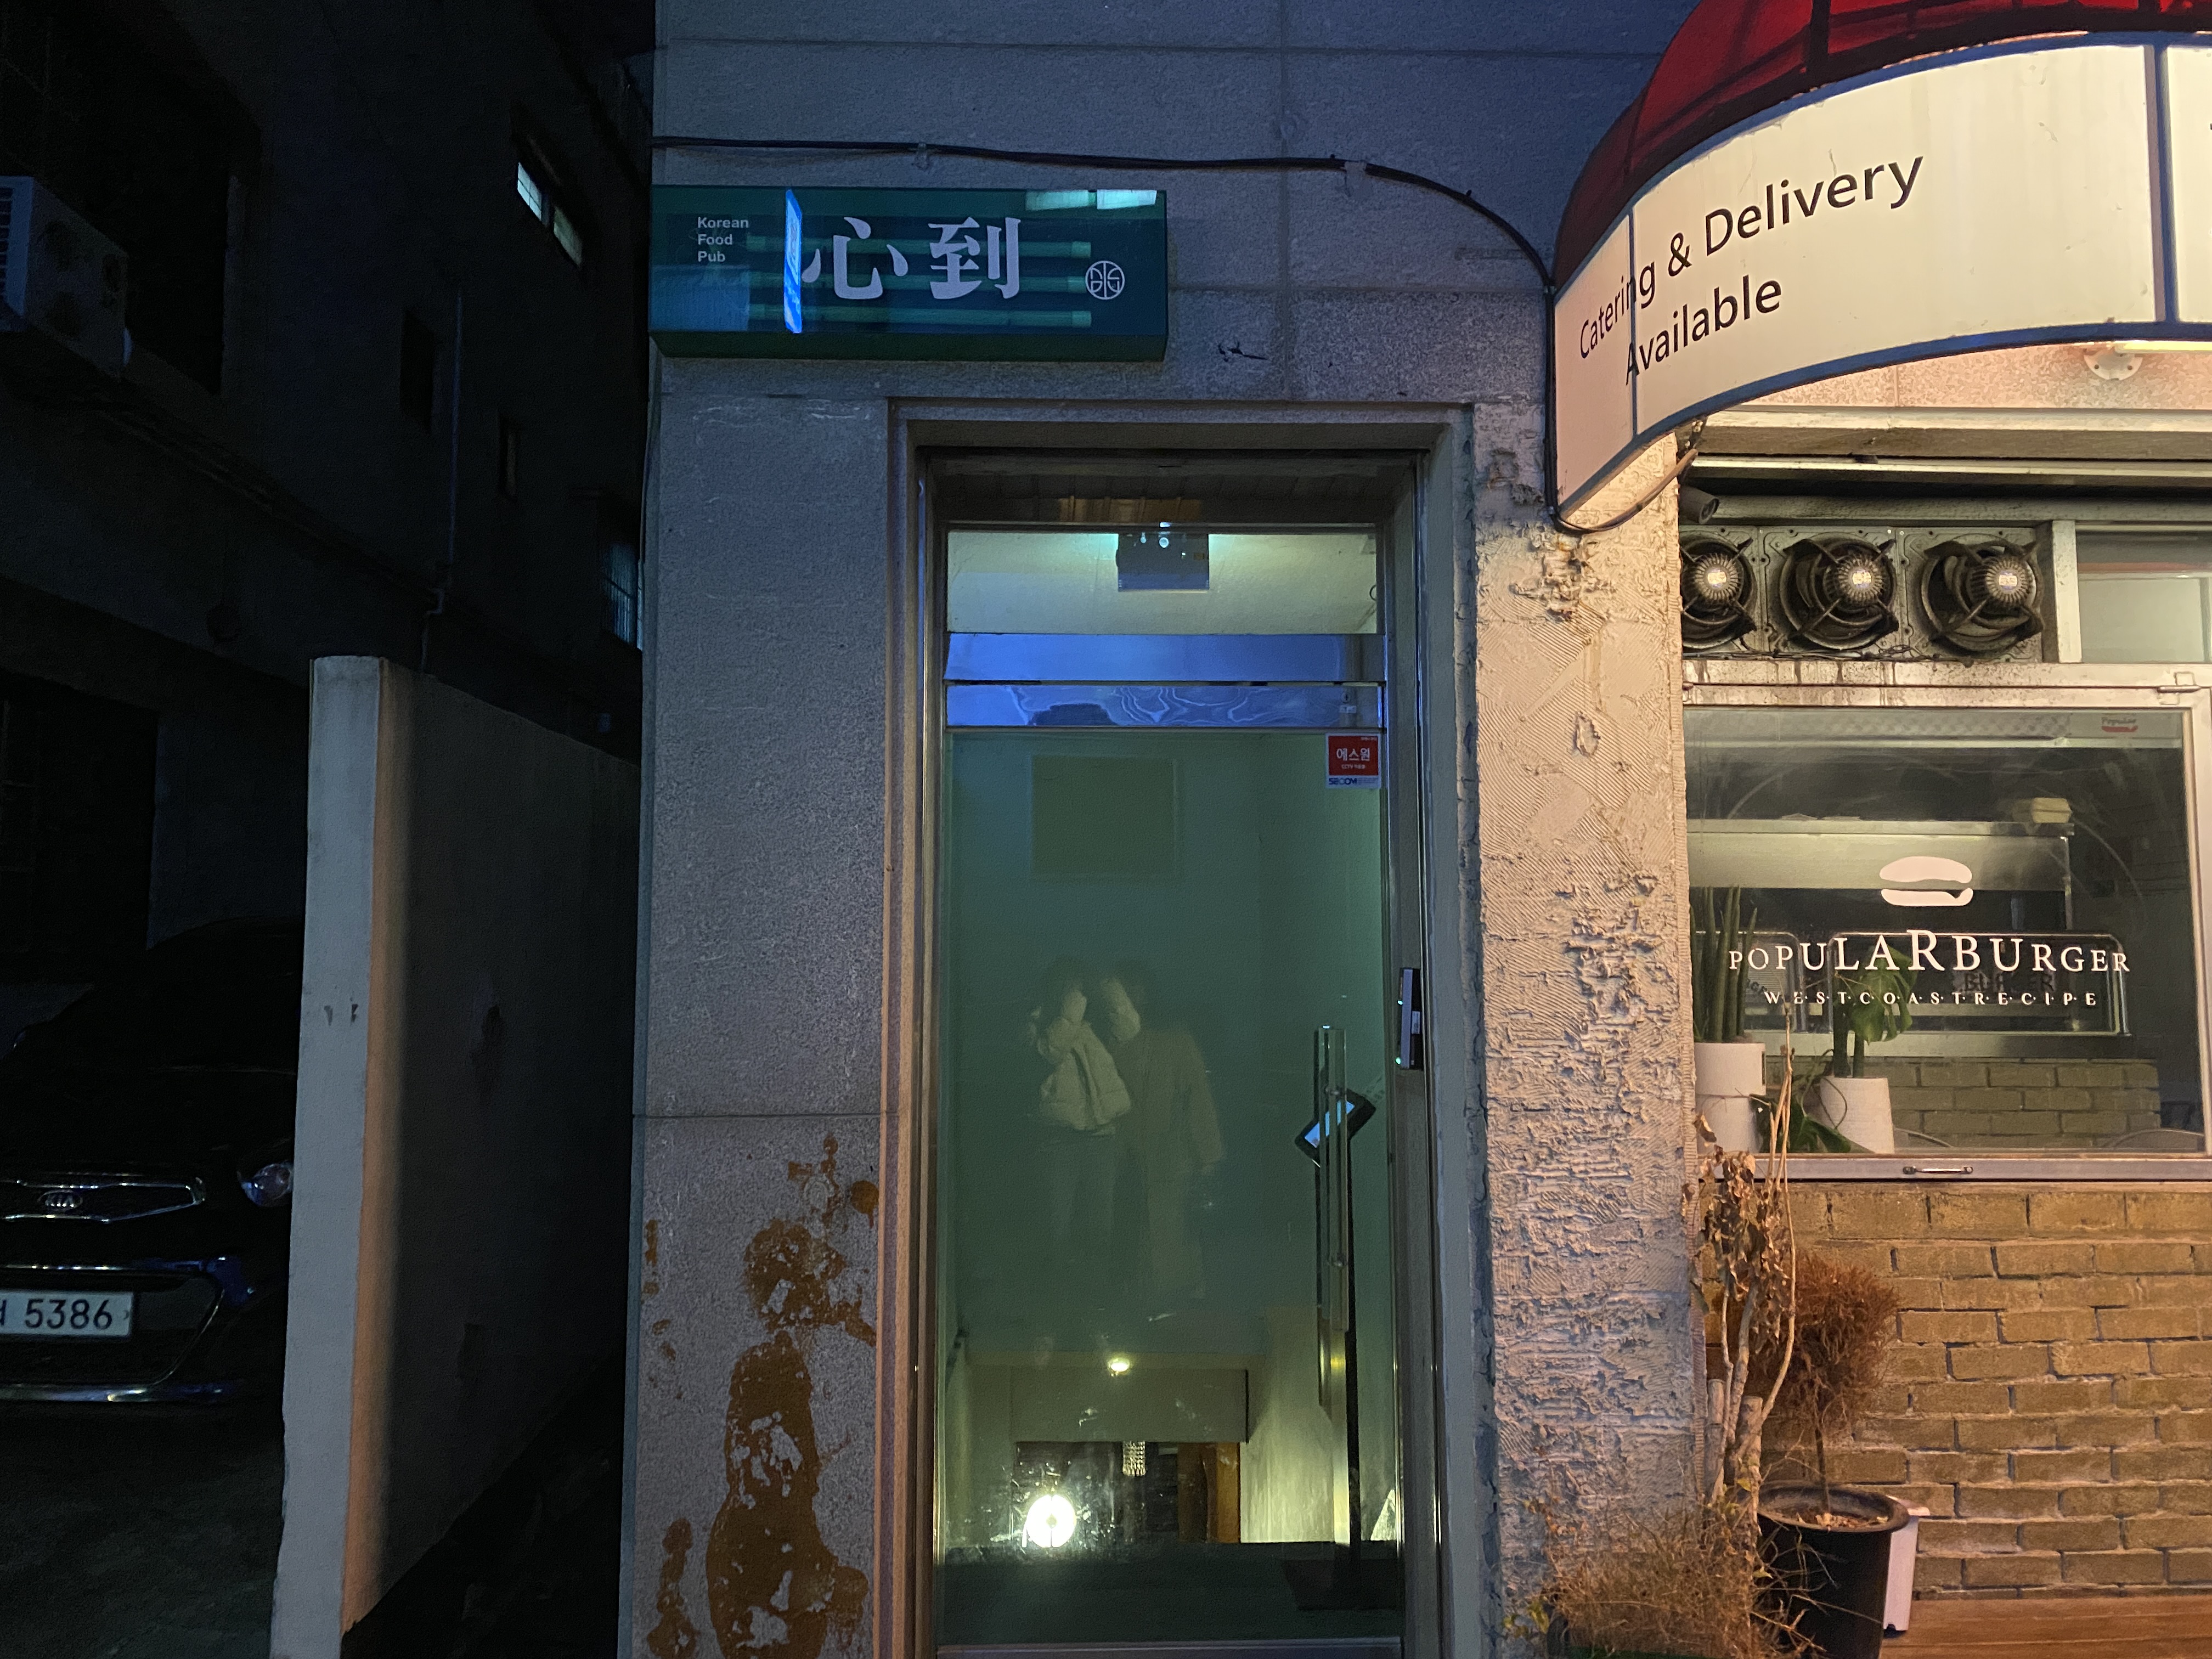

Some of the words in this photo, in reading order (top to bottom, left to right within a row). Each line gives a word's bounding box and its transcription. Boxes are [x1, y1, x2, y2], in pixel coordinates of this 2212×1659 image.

[697, 217, 749, 228] Korean
[697, 233, 733, 245] Food
[697, 250, 726, 262] Pub
[802, 216, 1021, 300] 心到
[1580, 260, 1656, 359] Catering
[1667, 232, 1692, 277] &
[1705, 156, 1923, 256] Delivery
[1626, 274, 1782, 386] Available
[1336, 747, 1370, 761] 에스원
[25, 1298, 112, 1330] 5386
